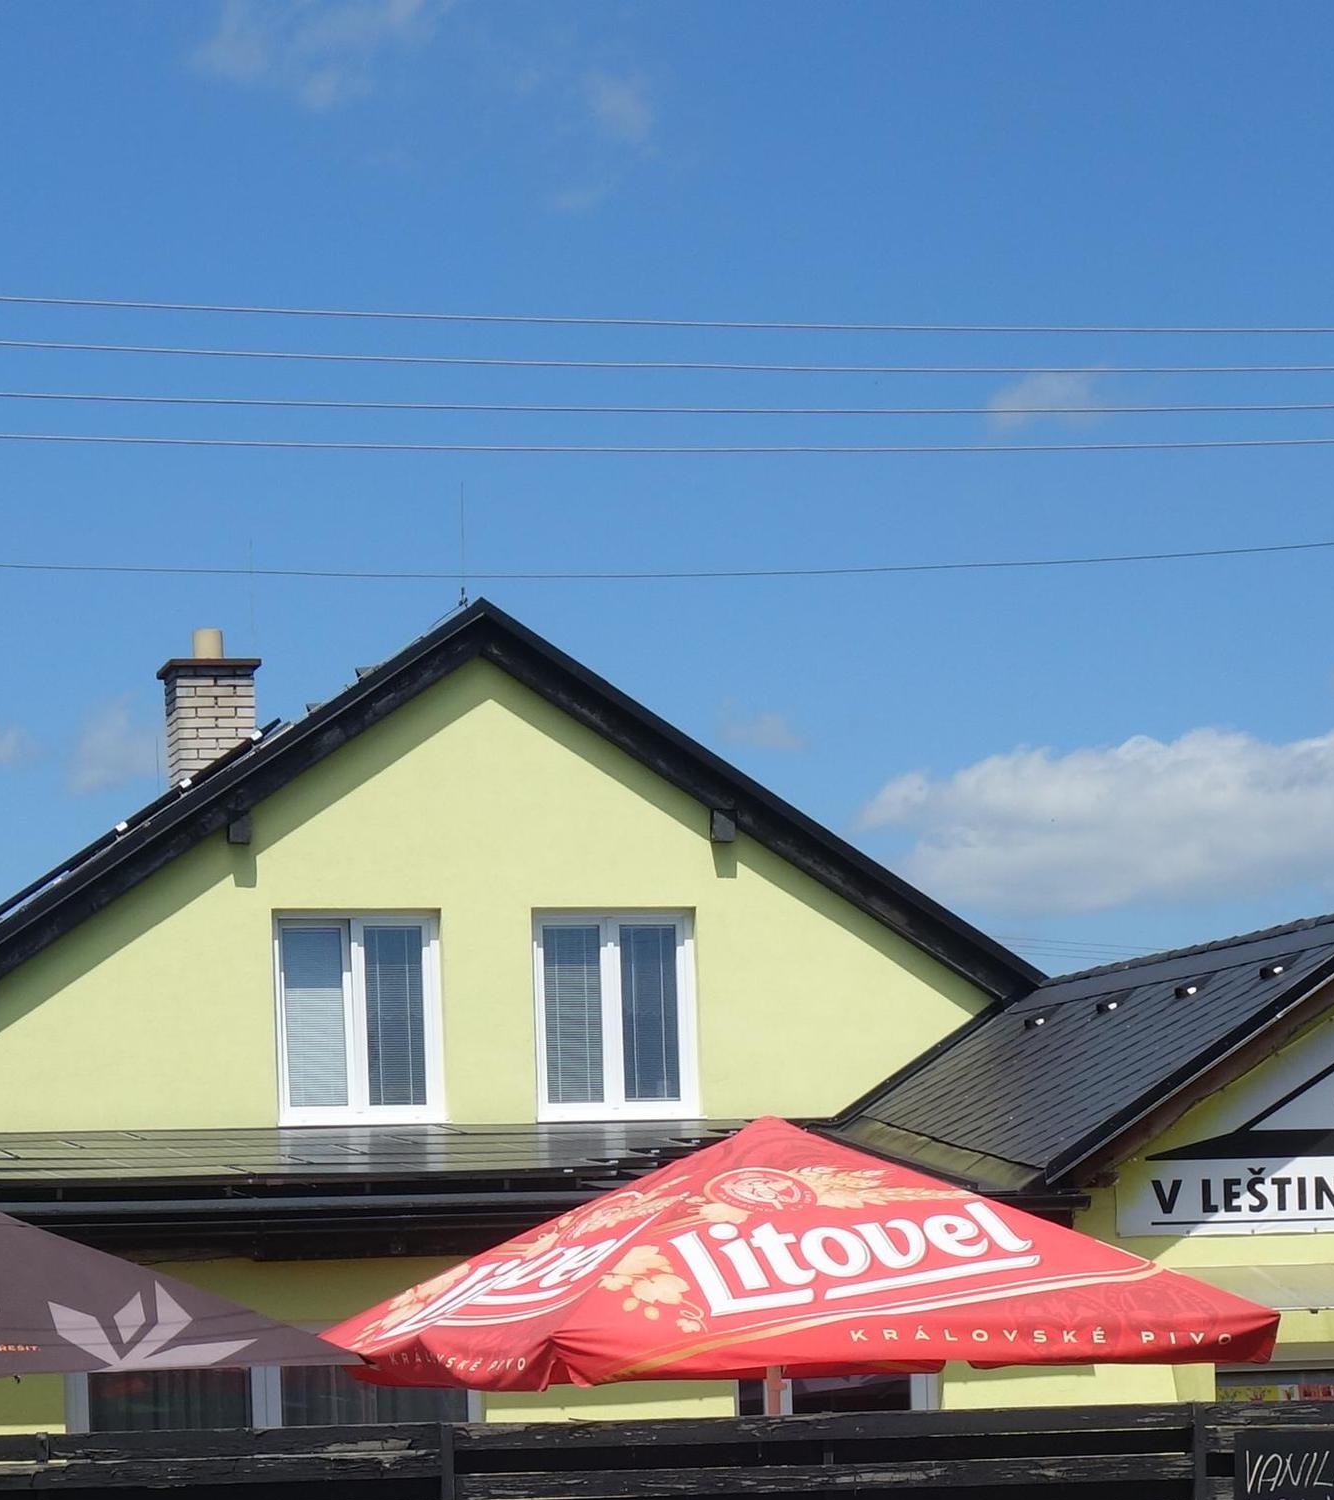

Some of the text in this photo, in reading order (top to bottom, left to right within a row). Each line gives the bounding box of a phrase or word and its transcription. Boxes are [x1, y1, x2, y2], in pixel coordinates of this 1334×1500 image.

[1151, 1180, 1182, 1214] V
[668, 1201, 1033, 1317] Litovel
[849, 1324, 1233, 1346] KRÁLOVSKÉ PIVO
